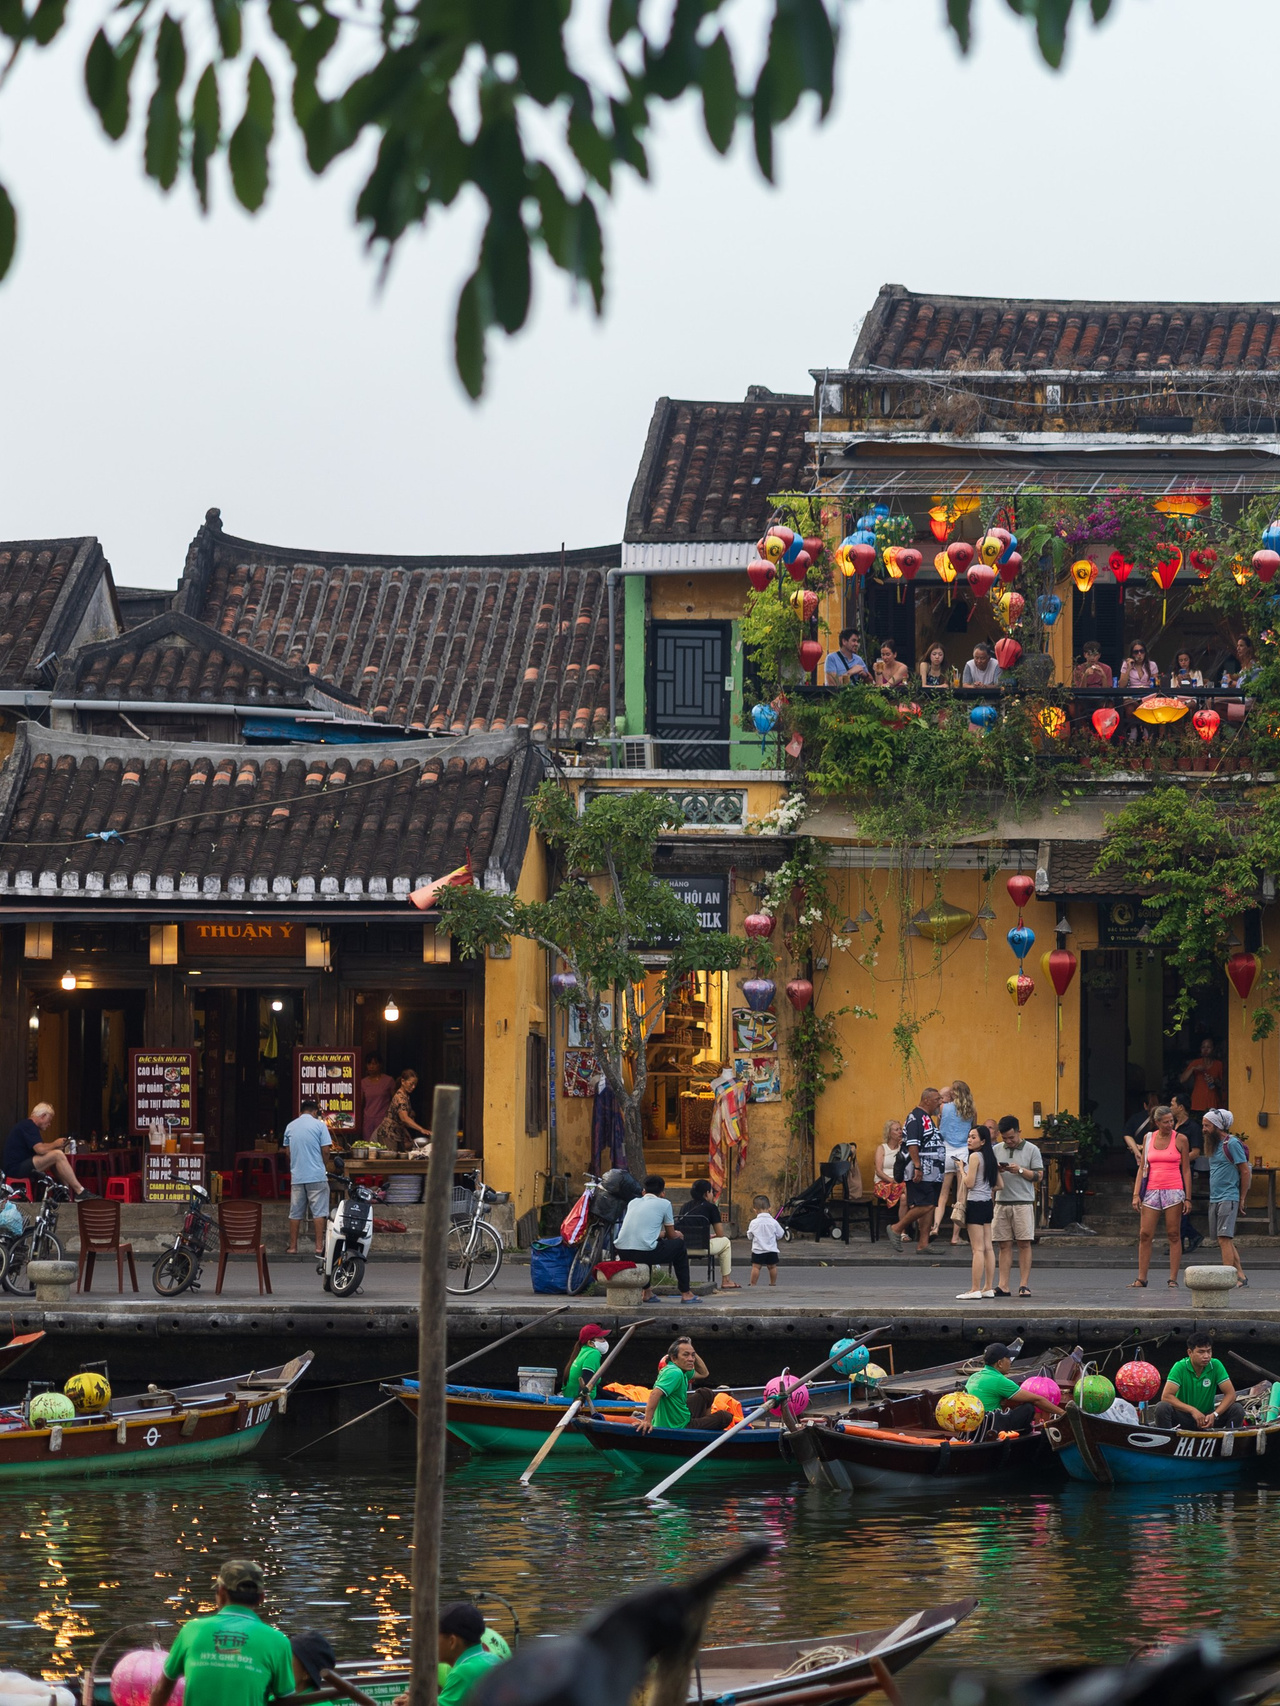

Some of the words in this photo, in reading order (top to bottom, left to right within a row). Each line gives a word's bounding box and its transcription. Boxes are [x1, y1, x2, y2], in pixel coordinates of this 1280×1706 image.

[684, 889, 702, 906] HỘI
[705, 892, 720, 904] AN
[696, 912, 722, 928] SILK
[197, 923, 273, 941] THUẬN
[279, 922, 293, 938] Ý
[137, 1066, 150, 1076] CAO
[151, 1064, 164, 1076] LẦU
[301, 1066, 316, 1078] CƠM
[318, 1064, 327, 1078] GÀ
[301, 1082, 315, 1097] THỊT
[316, 1081, 330, 1094] XIÊN
[331, 1081, 353, 1094] NƯỚNG
[149, 1099, 161, 1111] THỊT
[150, 1156, 160, 1168] TRÀ
[178, 1156, 189, 1168] TRÀ
[190, 1170, 201, 1180] CAM
[1174, 1437, 1196, 1456] HA
[1196, 1437, 1217, 1457] 171
